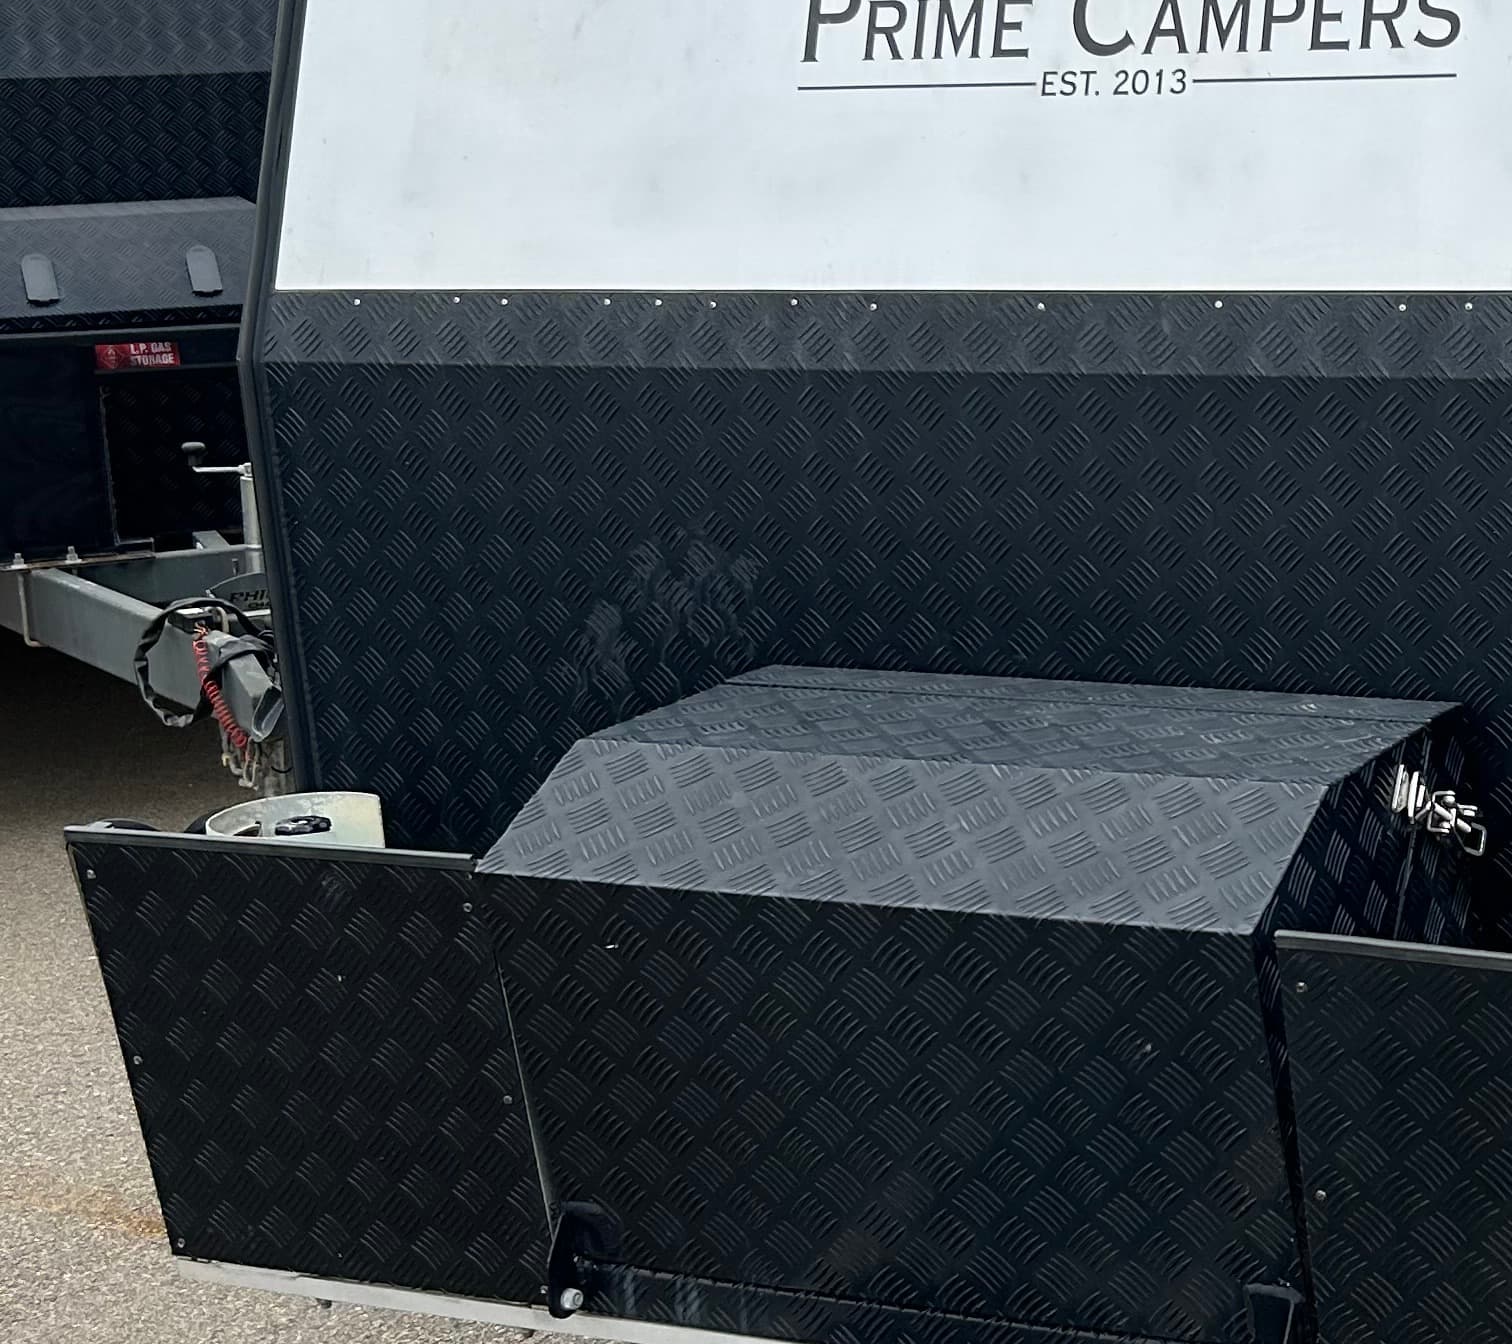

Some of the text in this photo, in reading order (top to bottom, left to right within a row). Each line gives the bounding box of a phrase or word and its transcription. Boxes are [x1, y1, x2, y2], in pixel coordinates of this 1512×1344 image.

[1040, 68, 1187, 97] EST. 2013
[150, 341, 172, 353] GAS
[129, 352, 175, 366] STORAGE
